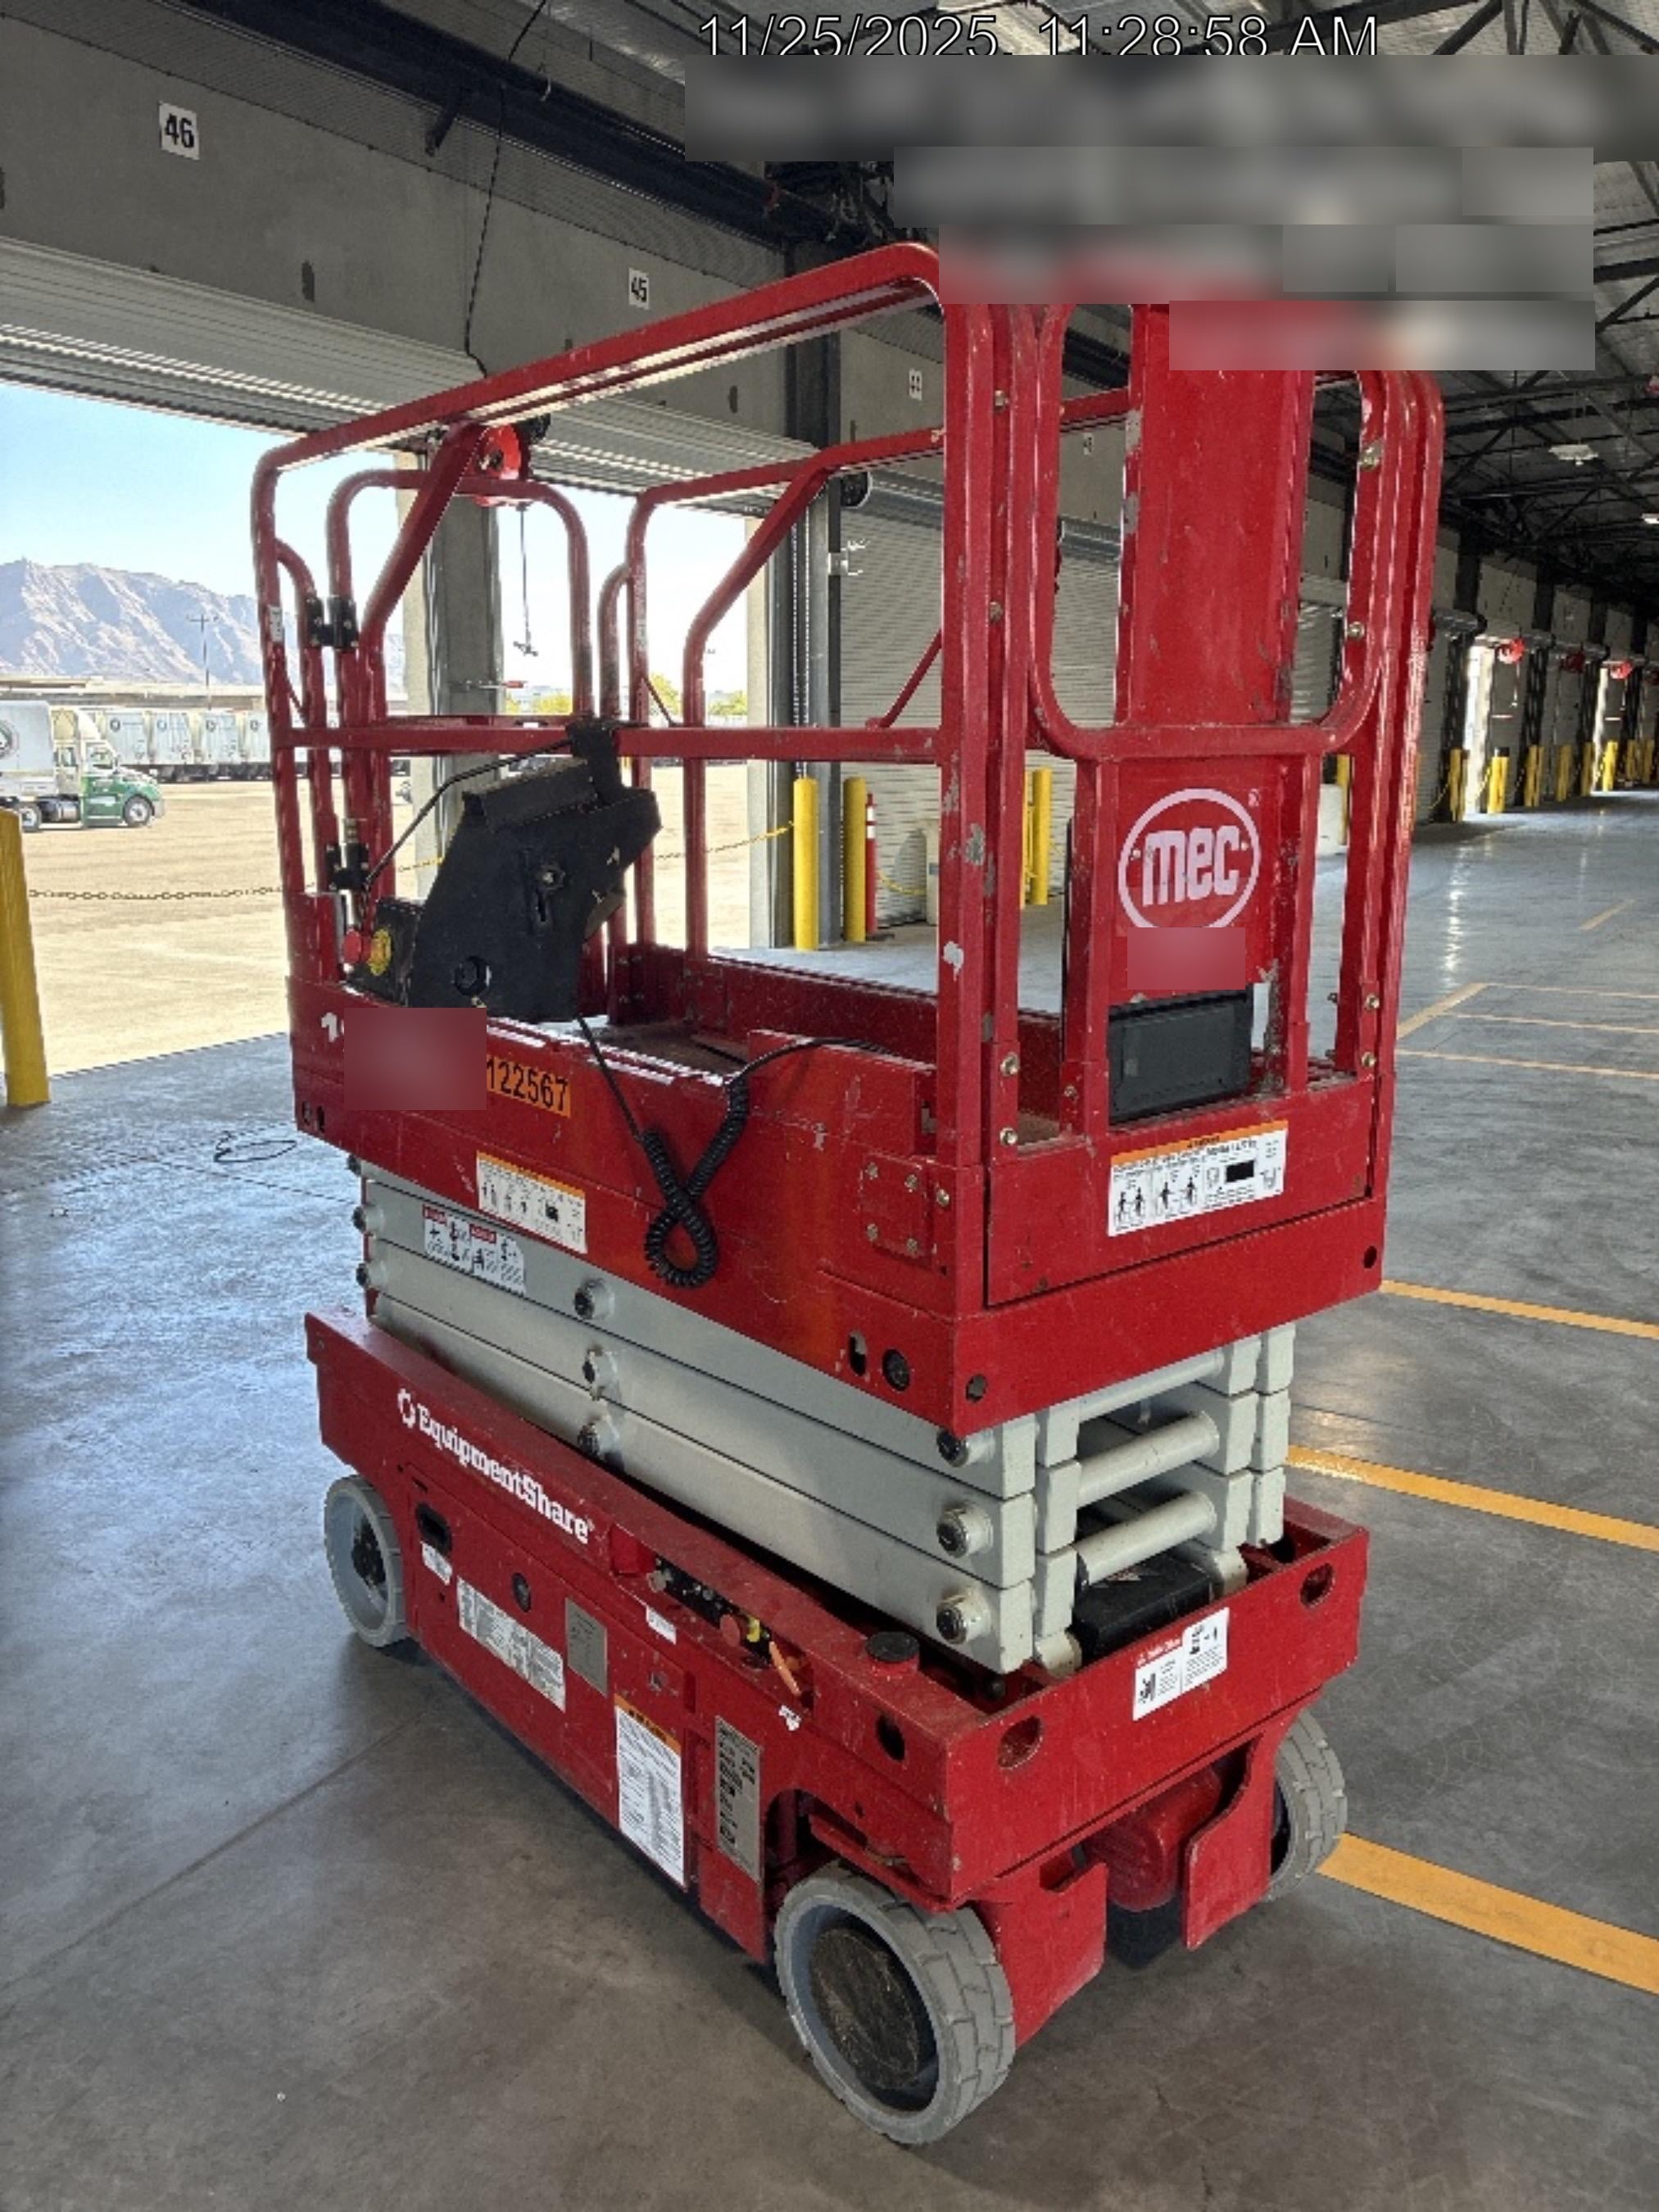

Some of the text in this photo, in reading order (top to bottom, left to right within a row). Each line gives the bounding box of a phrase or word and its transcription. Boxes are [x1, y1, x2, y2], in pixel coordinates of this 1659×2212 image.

[165, 113, 194, 148] 46
[631, 277, 647, 302] 45
[487, 1061, 569, 1112] 122567
[417, 1403, 588, 1545] EquipmentShare
